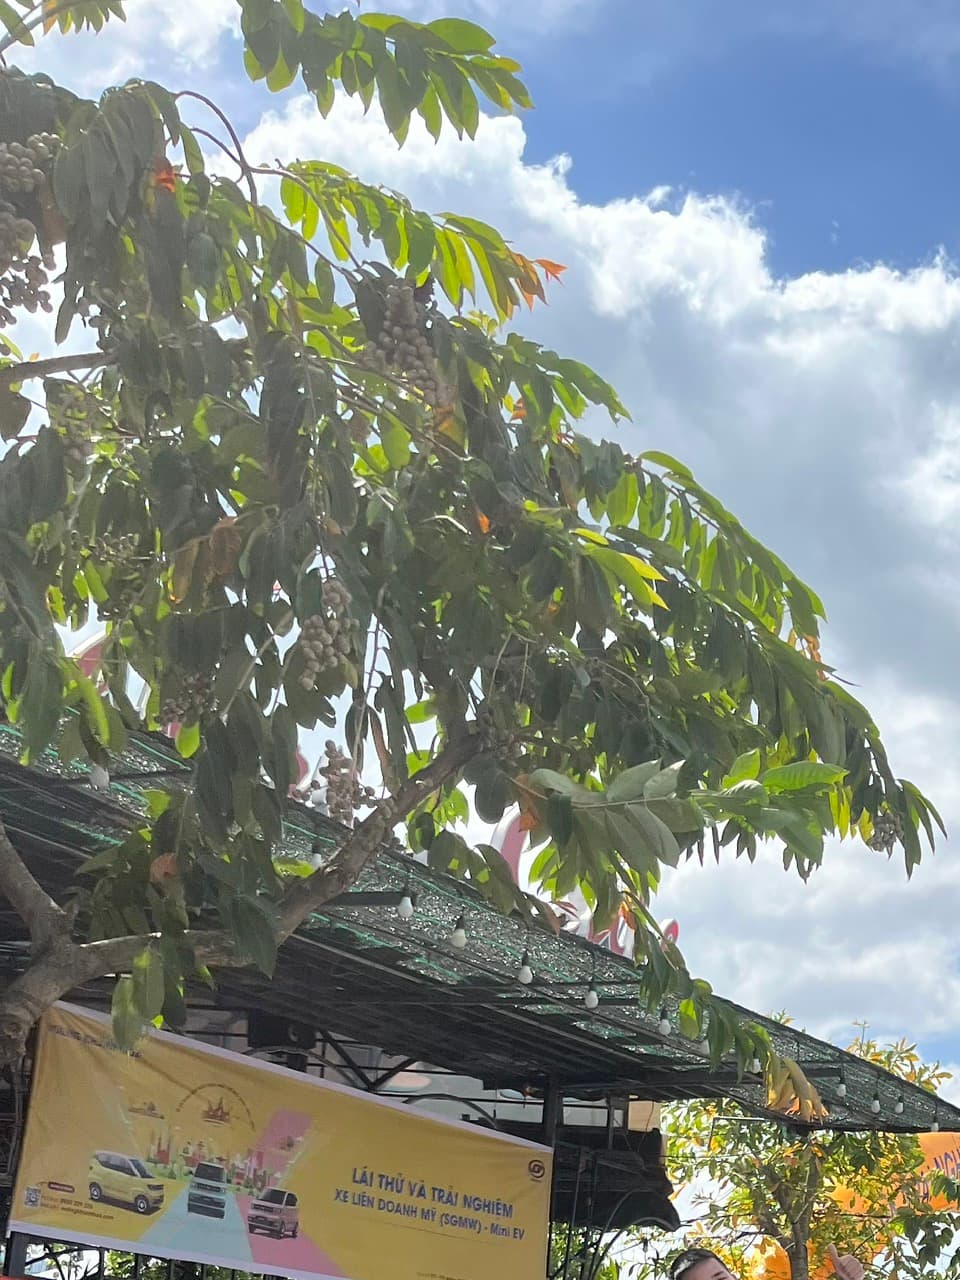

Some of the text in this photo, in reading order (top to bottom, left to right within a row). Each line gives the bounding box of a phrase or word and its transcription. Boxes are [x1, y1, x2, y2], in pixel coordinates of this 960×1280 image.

[335, 1188, 349, 1203] XE
[352, 1191, 375, 1209] LIÊN
[377, 1198, 418, 1218] DOANH
[439, 1212, 482, 1235] (SGMW)
[512, 1226, 526, 1241] EV
[352, 1166, 374, 1187] LÁI
[408, 1179, 427, 1199] VÀ
[463, 1193, 514, 1220] NGHIỆM
